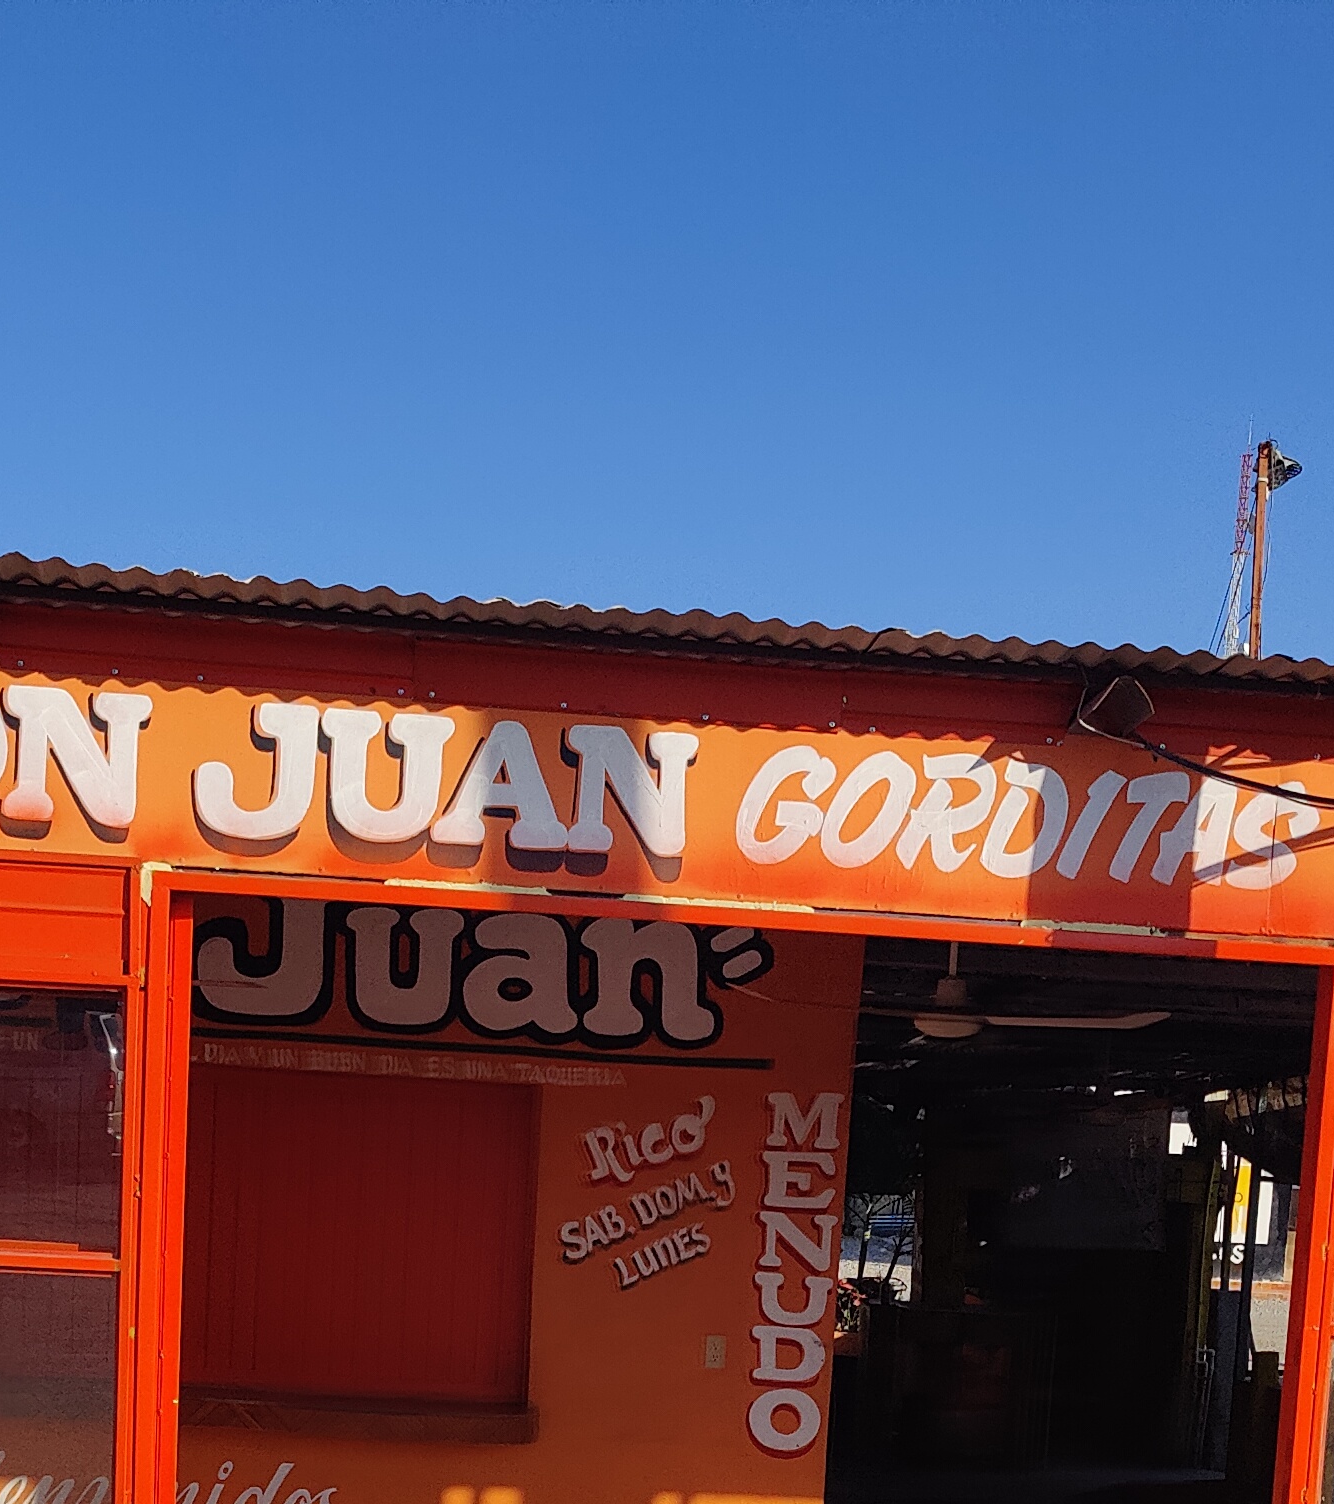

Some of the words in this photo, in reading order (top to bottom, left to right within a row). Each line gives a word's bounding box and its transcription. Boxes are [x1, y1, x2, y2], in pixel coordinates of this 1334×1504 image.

[191, 702, 700, 882] JUAN
[735, 745, 1322, 891] GORDITAS
[14, 1030, 38, 1051] UN
[192, 893, 725, 1048] Juan
[512, 1062, 628, 1087] TAQUERIA
[581, 1095, 716, 1184] Rico
[748, 1092, 845, 1459] MENUDO
